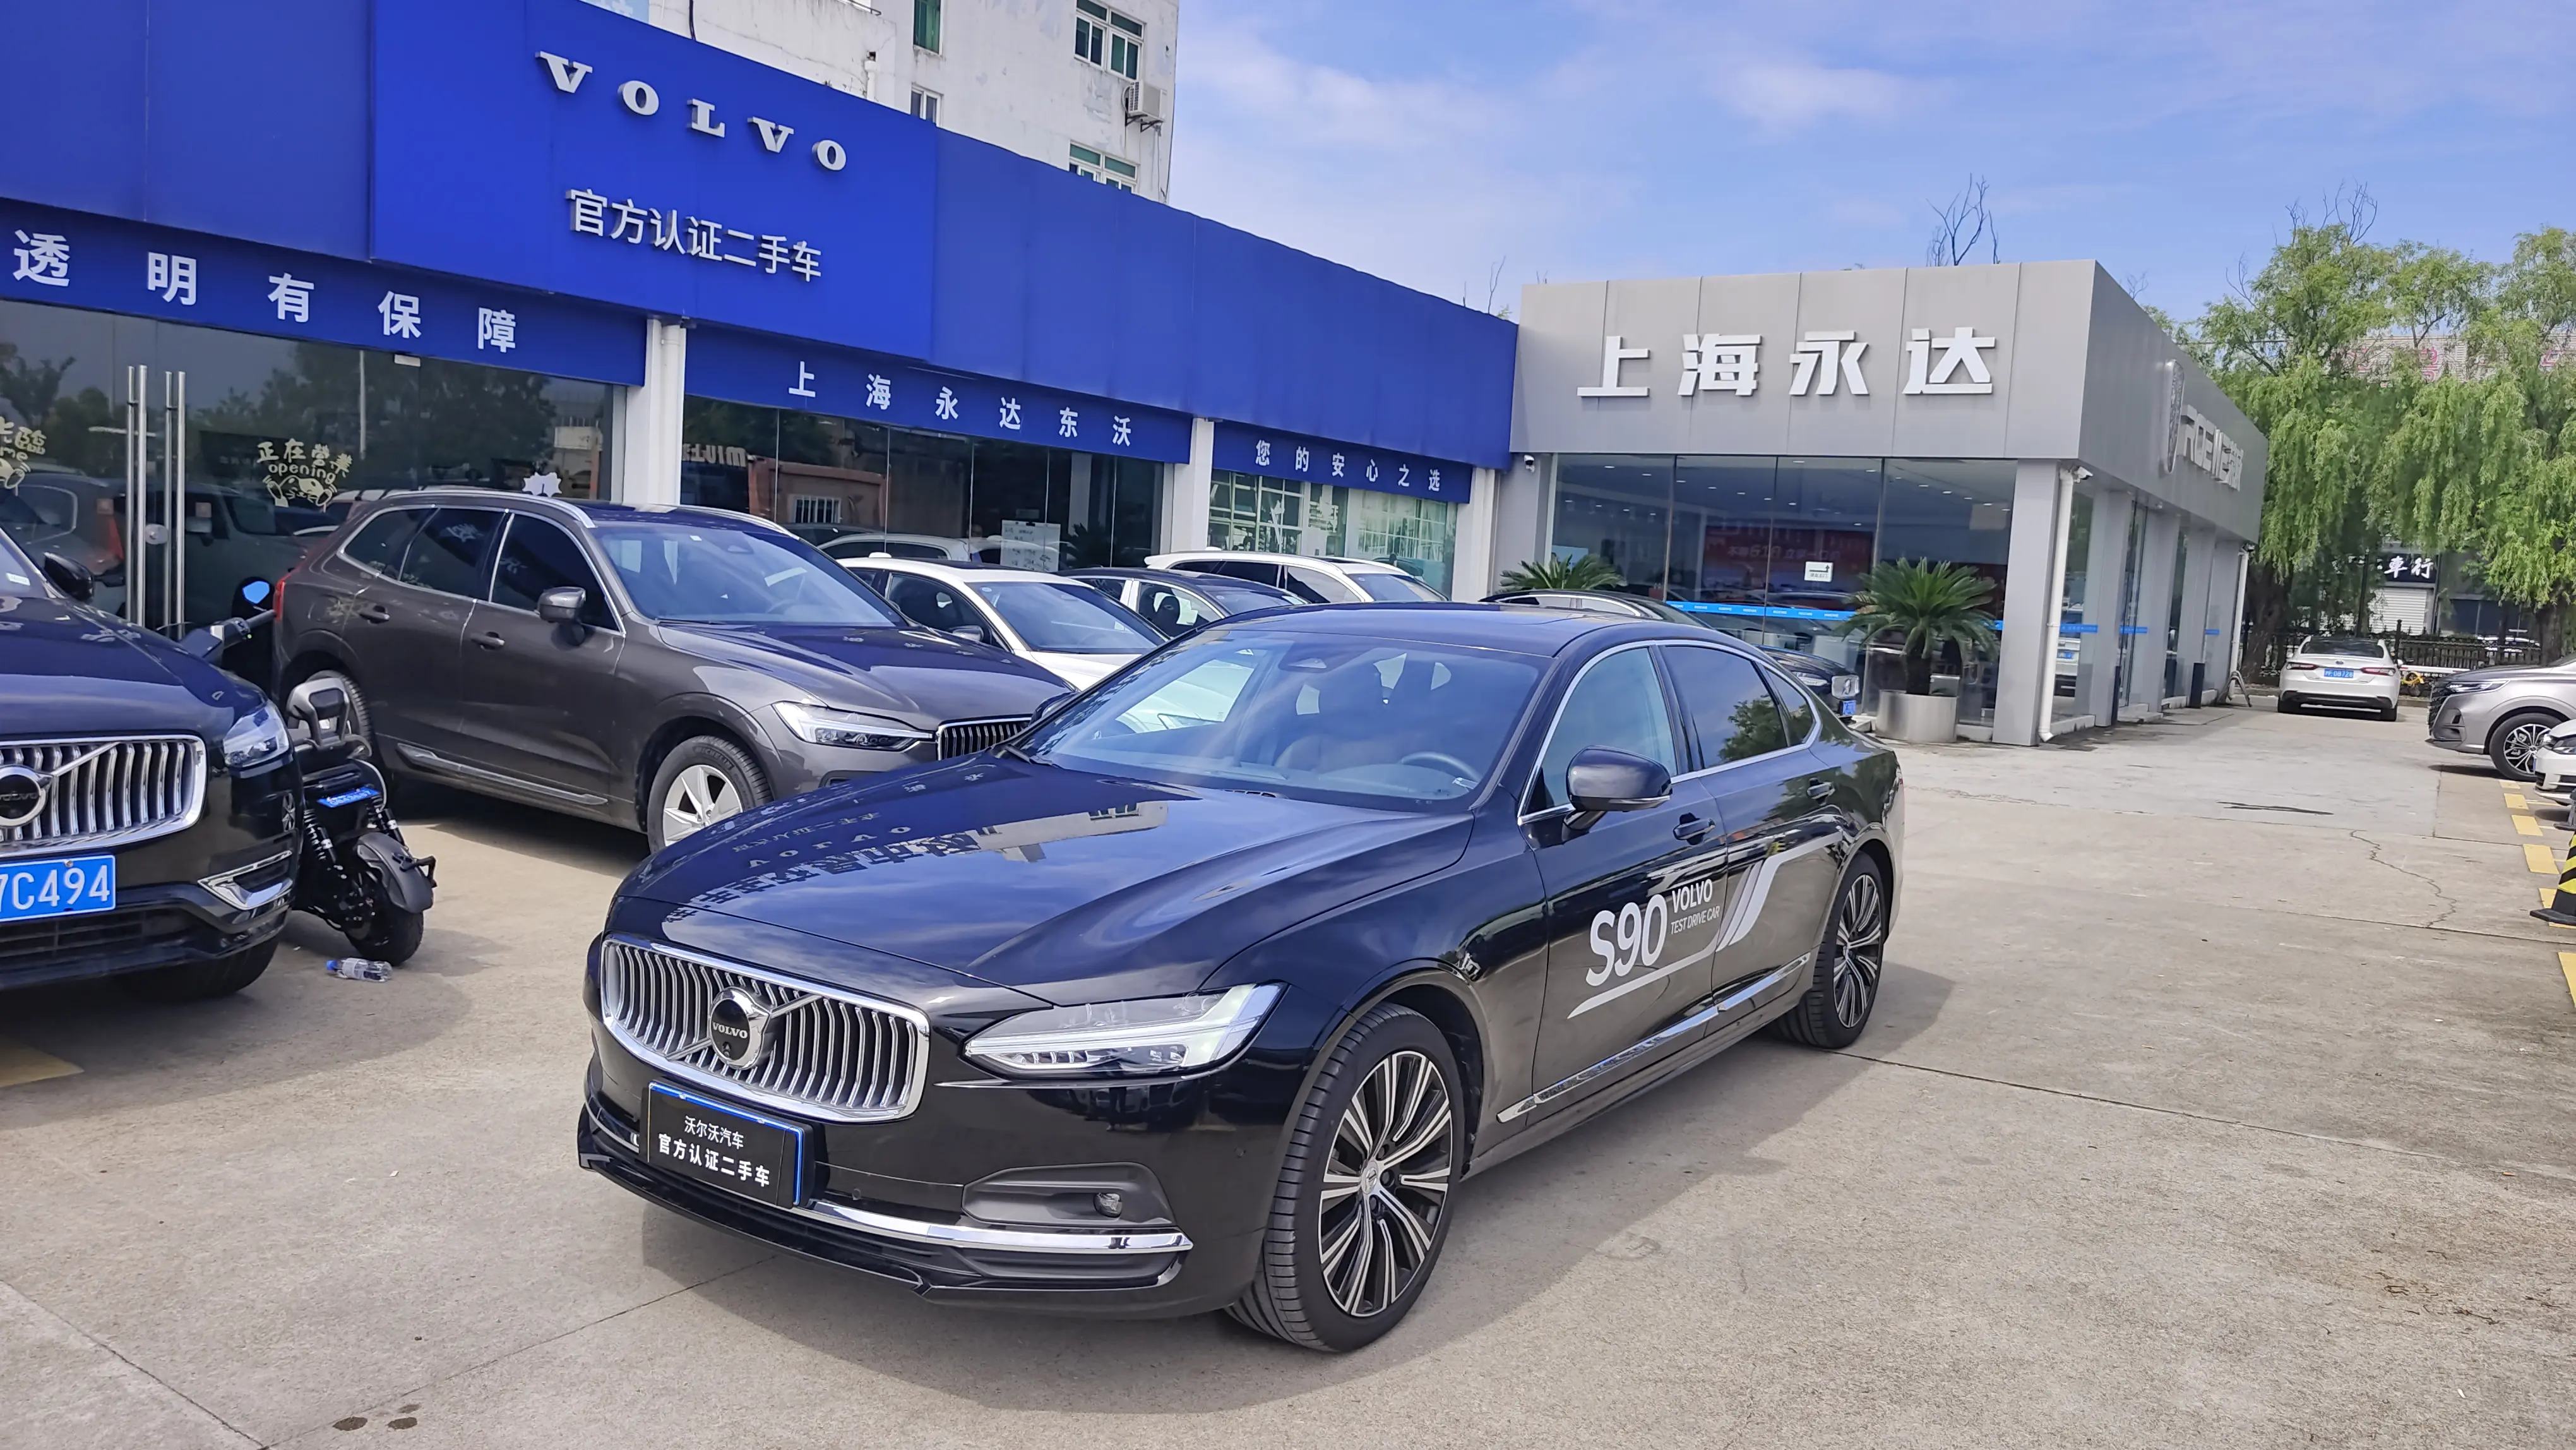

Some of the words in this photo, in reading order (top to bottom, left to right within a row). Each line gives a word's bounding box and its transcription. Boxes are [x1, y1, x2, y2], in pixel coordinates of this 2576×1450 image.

[535, 51, 847, 171] VOLVO
[566, 189, 821, 282] 官方认证二手车
[13, 229, 517, 354] 透明有保障
[1577, 327, 1996, 397] 上海永达
[789, 361, 1132, 447] 上海永达东沃
[268, 463, 336, 484] opening
[1255, 440, 1441, 493] 您的安心之选
[1671, 917, 1688, 935] TEST
[1687, 910, 1707, 929] DRIVE
[1707, 906, 1720, 921] CAR
[1672, 878, 1712, 913] VOLVO
[1585, 894, 1667, 986] S90
[712, 1021, 748, 1039] VOLVO
[684, 1115, 744, 1149] 沃尔沃汽车
[659, 1134, 770, 1187] 官方认证二手车
